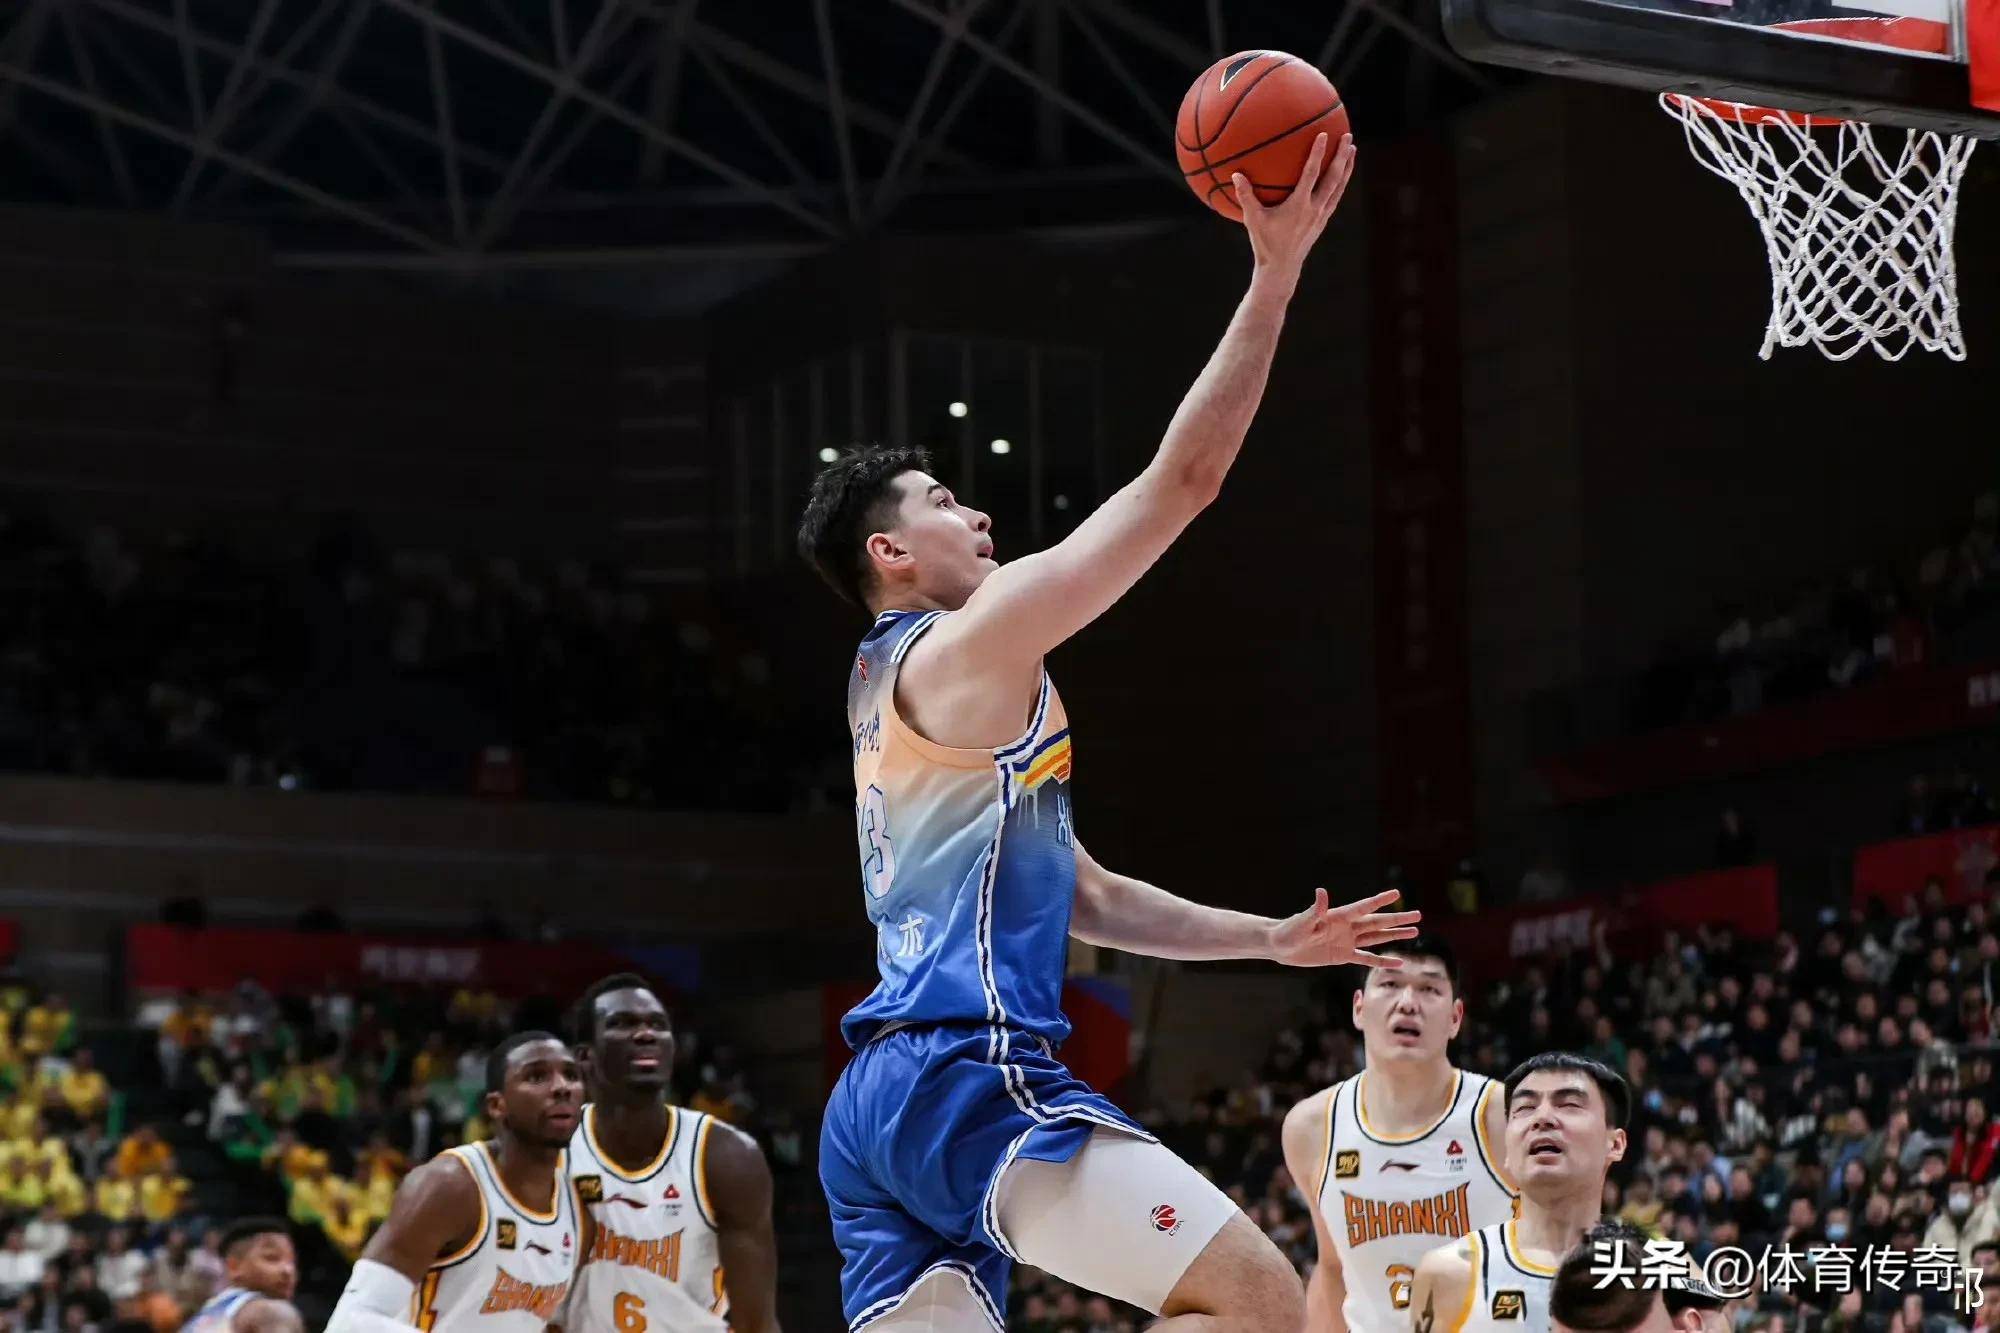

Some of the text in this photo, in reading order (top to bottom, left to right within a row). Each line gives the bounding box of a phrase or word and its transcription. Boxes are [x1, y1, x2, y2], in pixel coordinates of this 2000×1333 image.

[856, 784, 896, 900] 3
[1341, 1181, 1471, 1248] SHANXI
[588, 1224, 685, 1282] HANXI
[613, 1291, 647, 1333] 6
